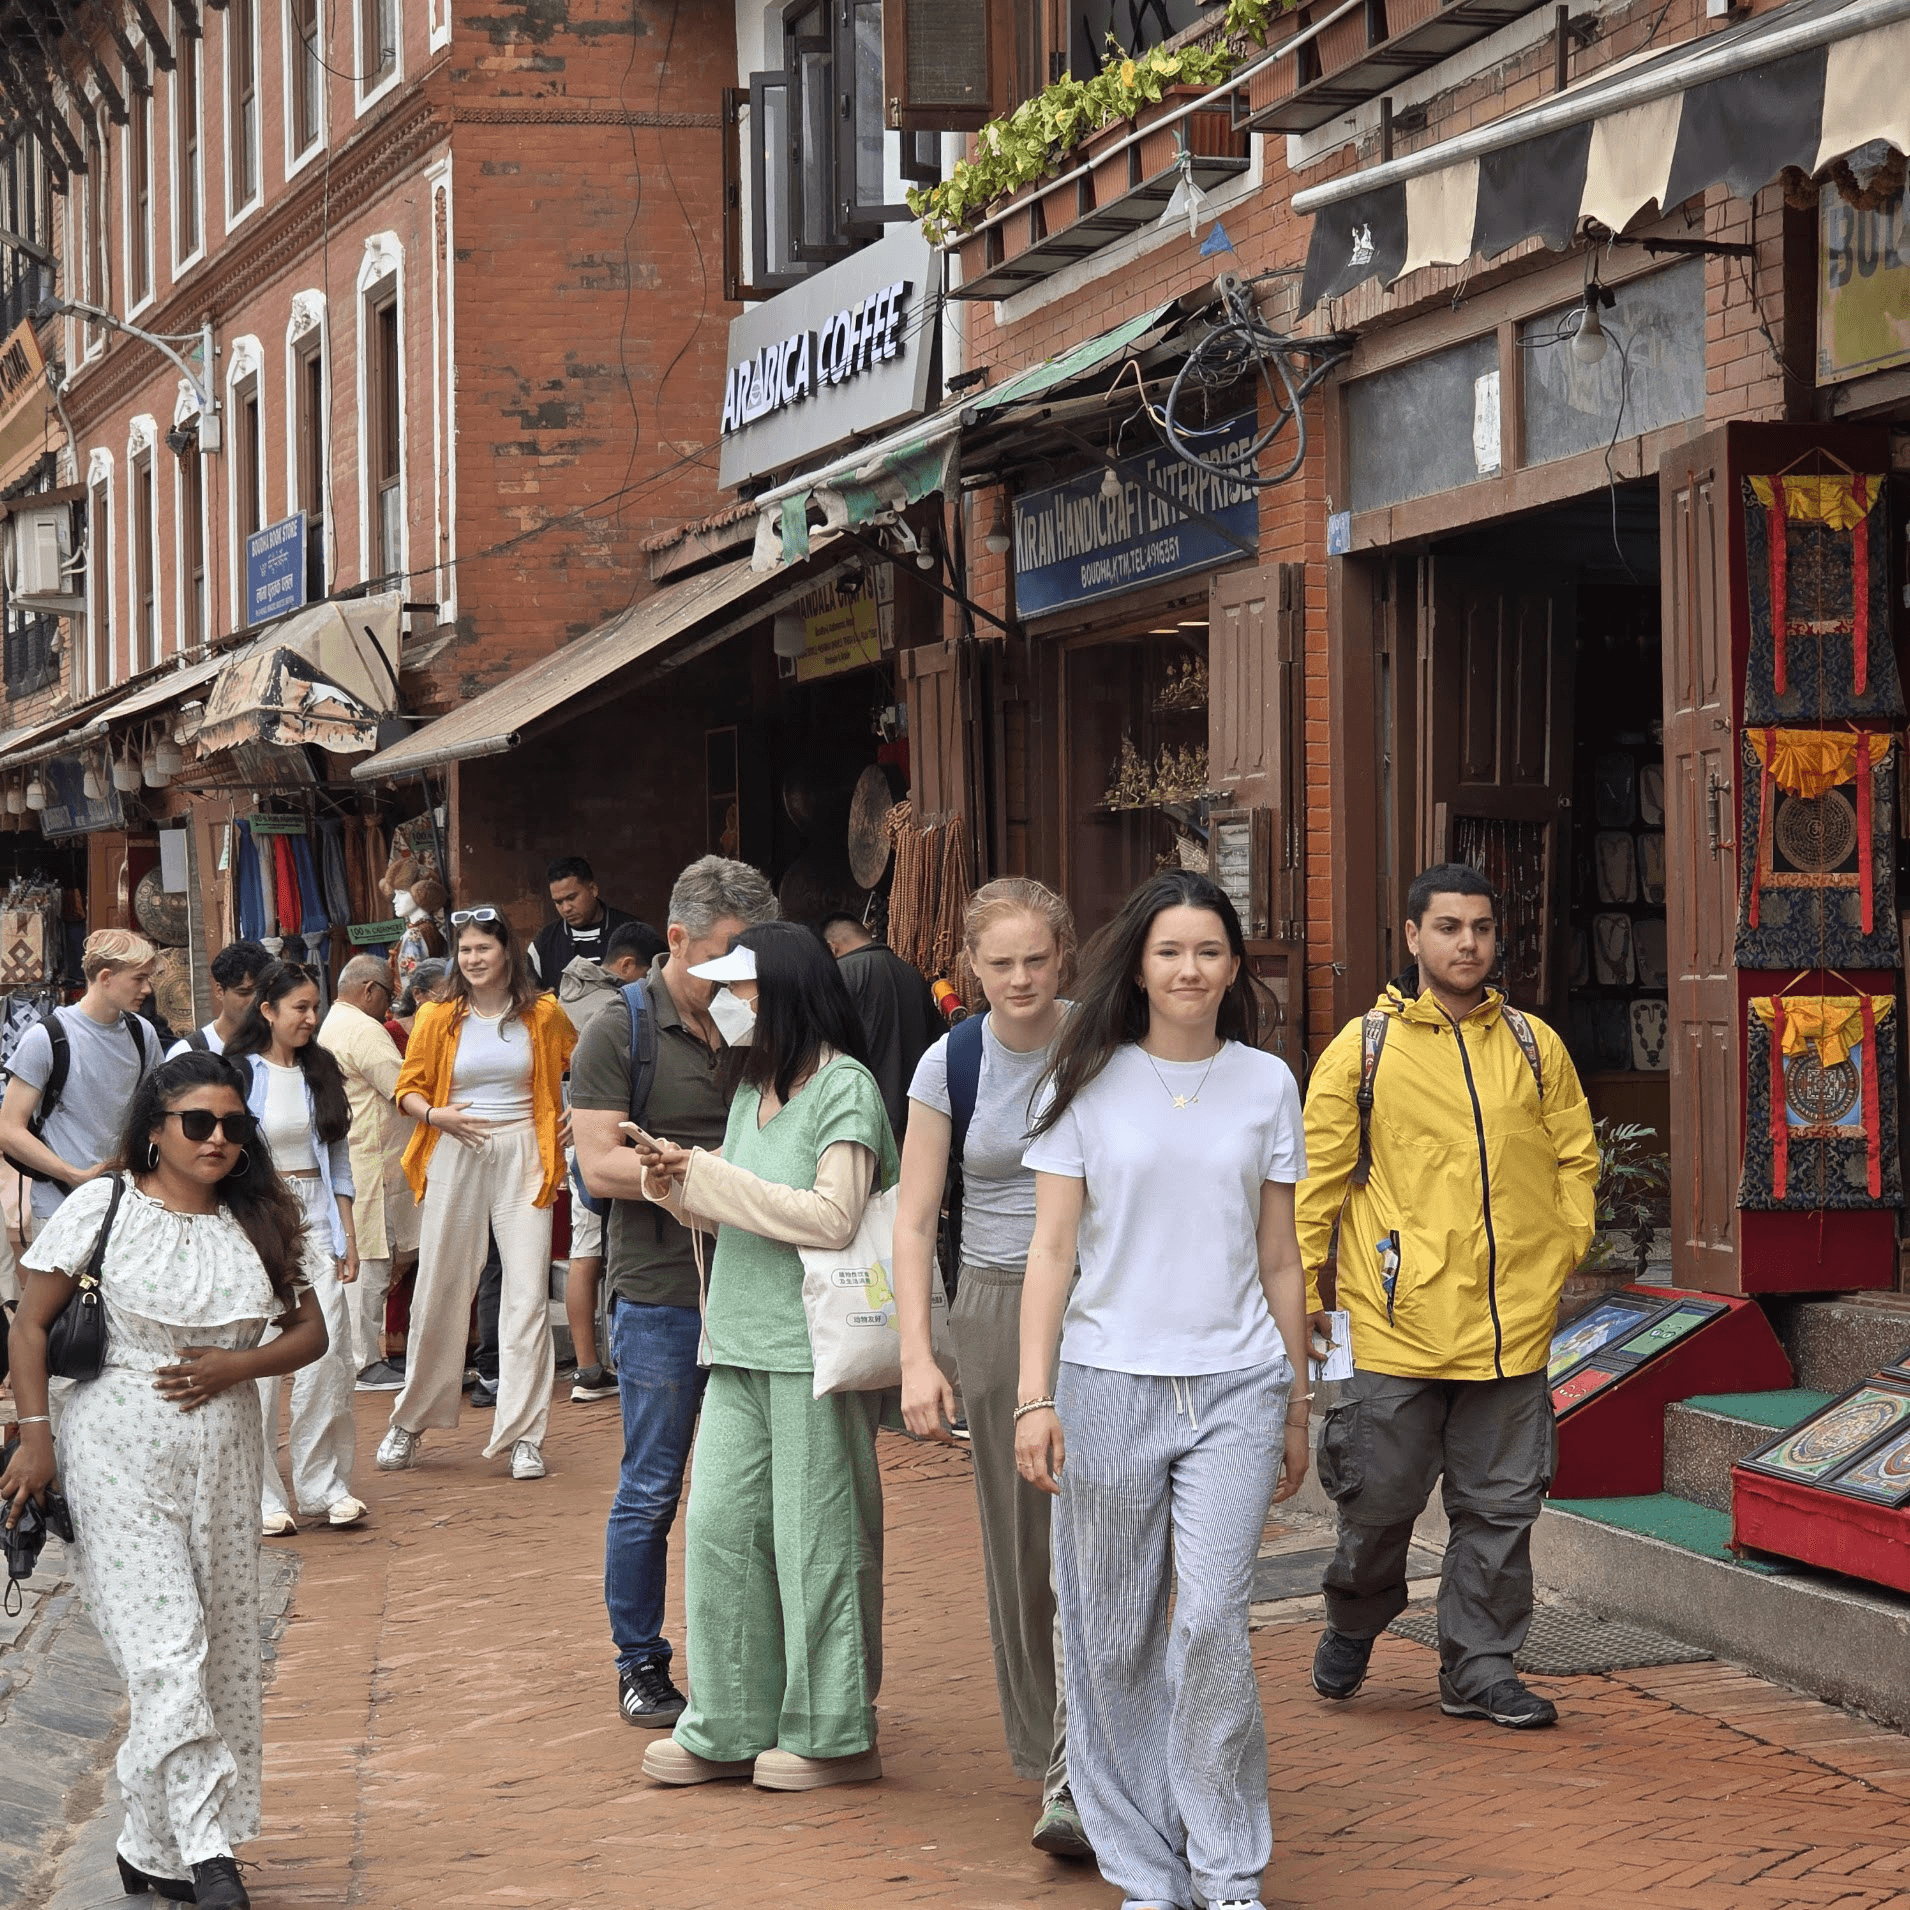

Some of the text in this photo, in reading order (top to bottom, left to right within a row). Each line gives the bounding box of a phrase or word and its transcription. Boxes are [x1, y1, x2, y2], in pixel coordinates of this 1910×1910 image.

[721, 281, 904, 434] ARABICA COFFEE
[251, 519, 298, 558] BOUDHA BOOK STORE
[1014, 506, 1056, 573] KIRAN
[1055, 481, 1144, 561] HANDICRAFT
[371, 923, 403, 935] CASHMERE
